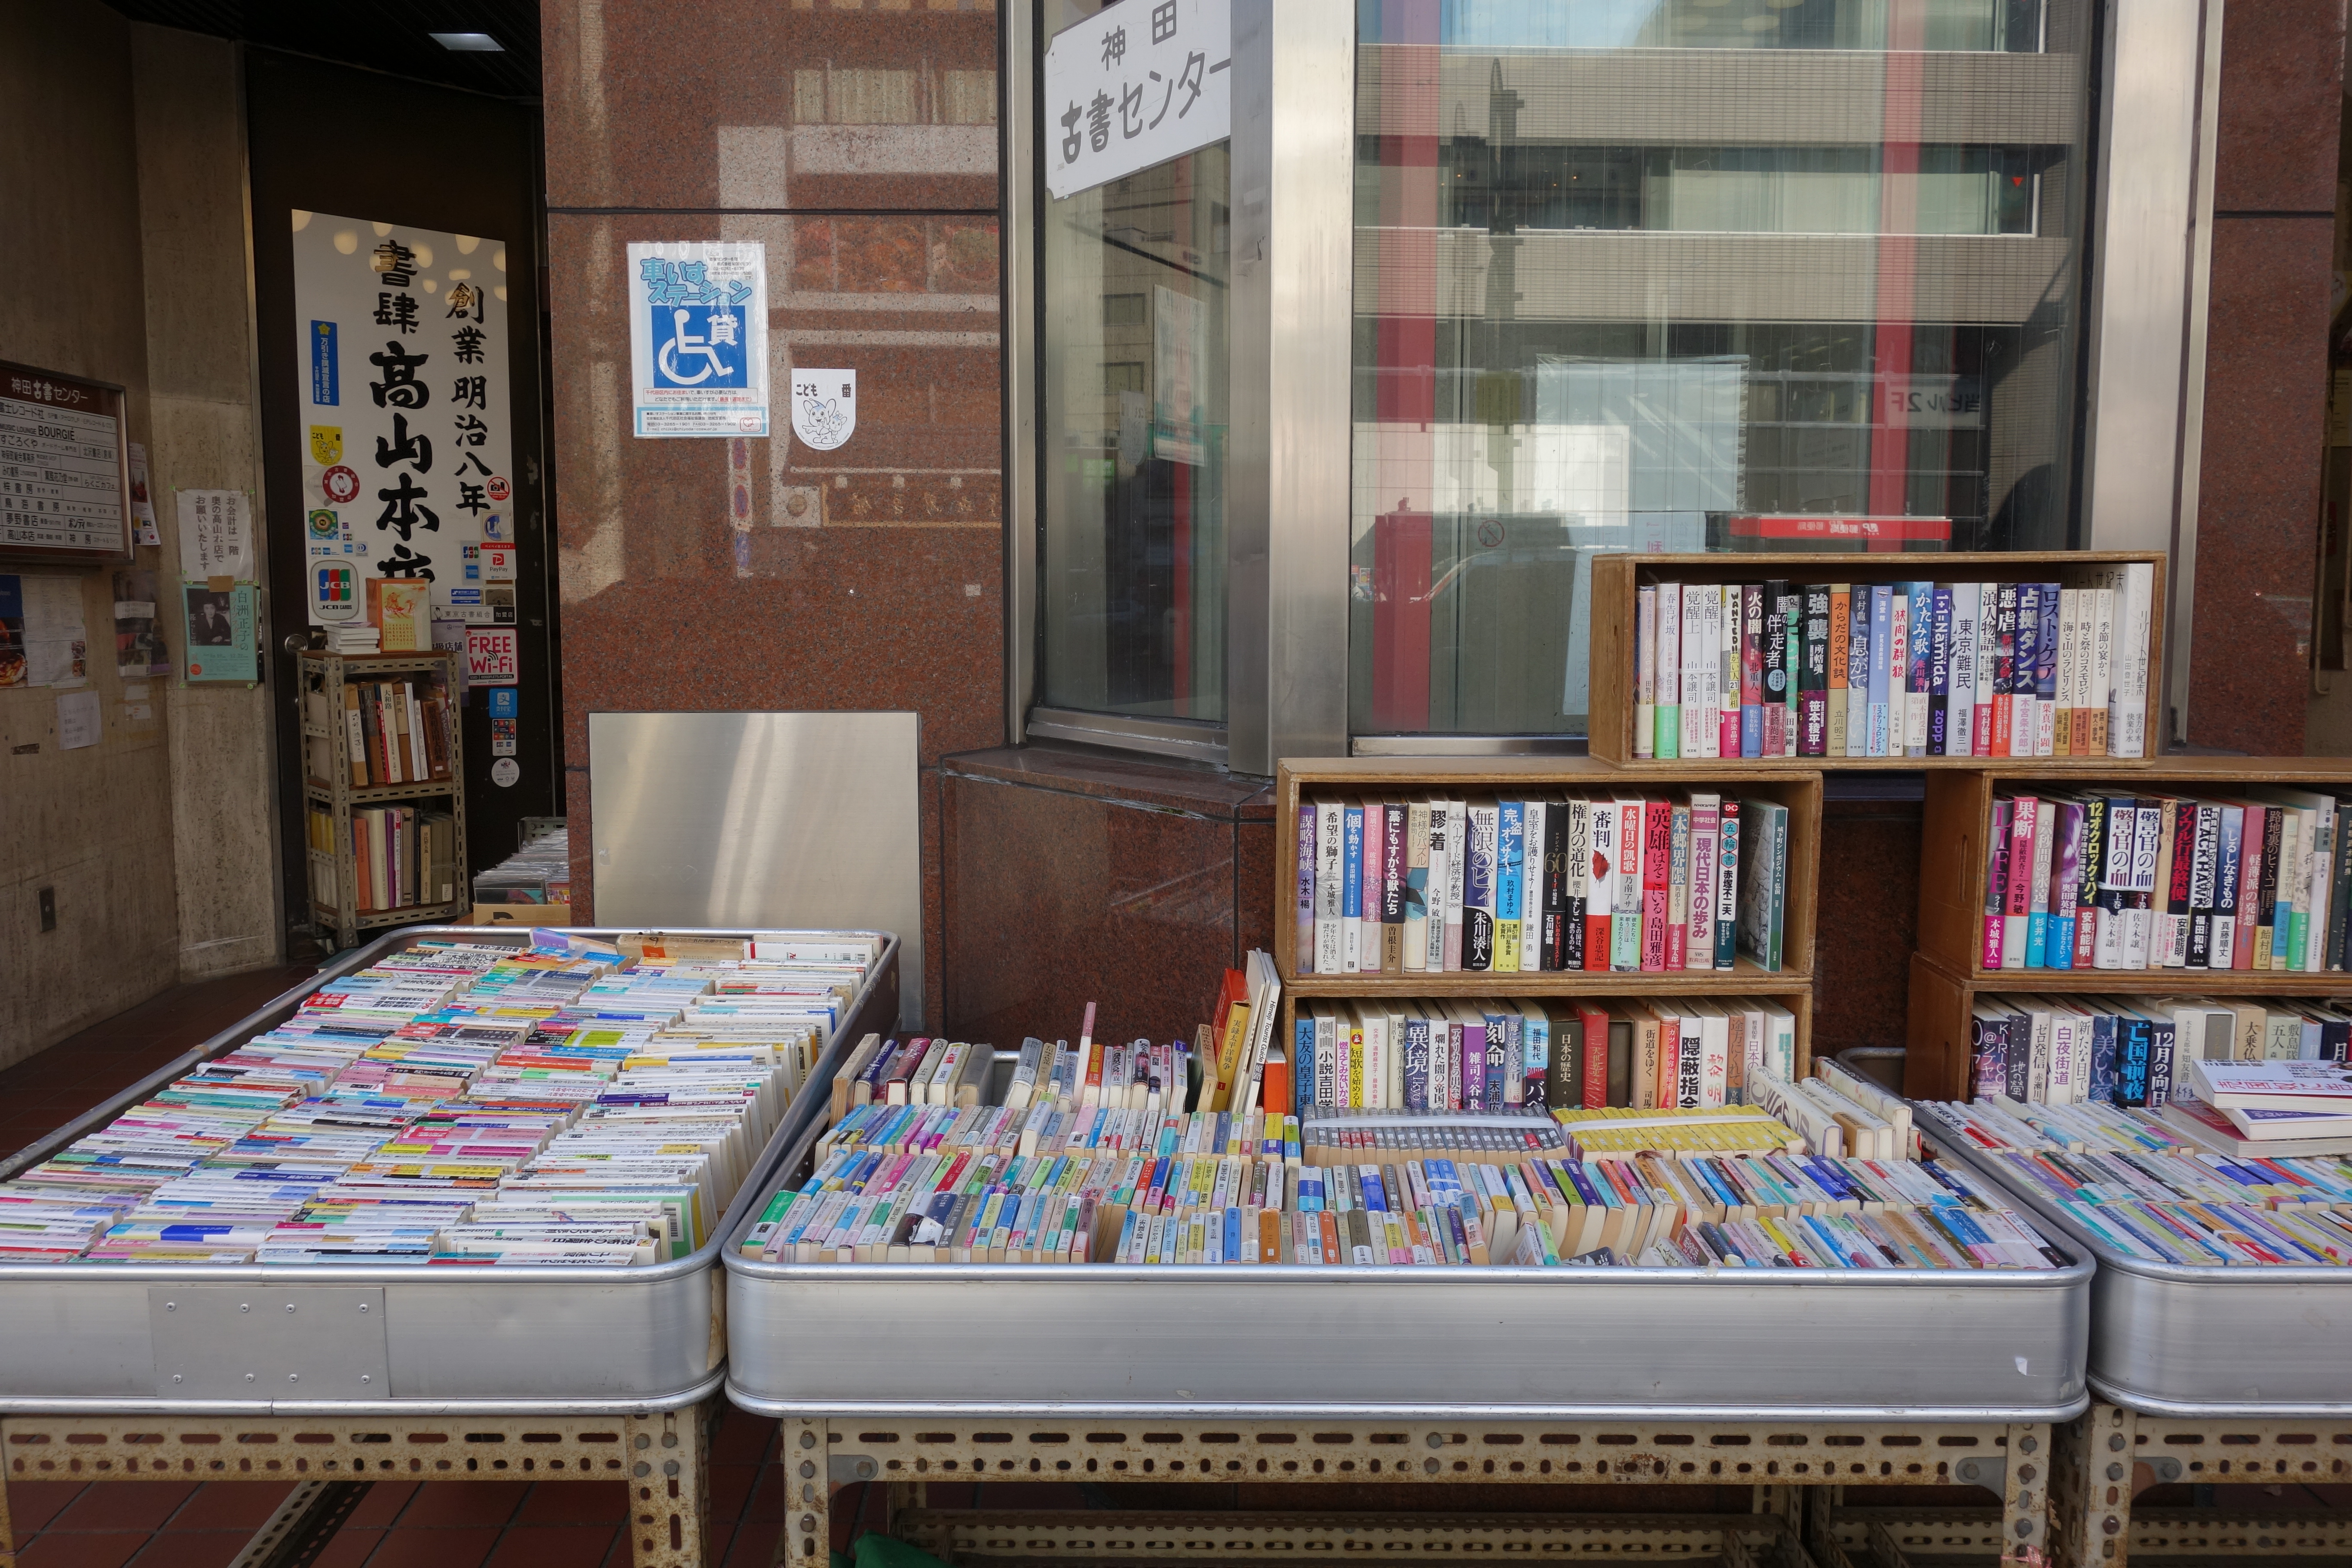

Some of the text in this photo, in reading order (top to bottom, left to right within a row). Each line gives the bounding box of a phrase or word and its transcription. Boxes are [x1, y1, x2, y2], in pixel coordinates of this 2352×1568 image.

[1102, 0, 1176, 71] 神田
[1061, 51, 1231, 164] 古書センター
[374, 240, 420, 334] 書肆
[640, 257, 708, 285] 車いす
[648, 280, 752, 307] ステーション
[707, 314, 738, 346] 貸
[12, 377, 88, 403] 神田古書センター
[445, 282, 493, 518] 創業明治八年
[796, 383, 818, 397] こども
[0, 435, 38, 449] すごろくや
[38, 425, 75, 441] BOURGIÉ
[84, 479, 115, 490] らくごカフェ
[7, 530, 35, 542] 高山本店
[196, 495, 209, 571] お願いいたします
[211, 496, 225, 563] 奥の高山本店で
[227, 496, 239, 556] お会計は一階
[237, 591, 250, 650] 白洲正子の
[445, 610, 490, 619] 東京古書組合
[1665, 593, 1675, 635] 春告げ坂
[1748, 592, 1762, 634] 火の闇
[1807, 593, 1828, 640] 強襲
[1913, 593, 1931, 654] かたみ歌
[1997, 588, 2017, 631] 悪虐
[432, 641, 463, 652] 扱店舗
[469, 636, 511, 653] FREE
[1766, 597, 1788, 668] 闇の 伴走者
[1834, 601, 1847, 678] からだの文化誌
[1956, 619, 1973, 689] 東京難民
[2016, 588, 2040, 687] 占拠ダンス
[2038, 591, 2058, 680] ロスト・ケア
[2098, 622, 2110, 678] 季節の宴から
[469, 656, 513, 673] Wi-Fi
[1644, 639, 1653, 676] 花合せ
[1749, 662, 1758, 691] 北重人
[2061, 622, 2074, 702] 海と山のラビリンス
[2079, 622, 2092, 704] 時と祭のコスモロジー
[1850, 636, 1868, 738] 息ができない
[1770, 707, 1779, 745] 長崎尚志
[1809, 701, 1820, 745] 笹本稜平
[1834, 710, 1844, 740] 立川昭二
[1957, 709, 1967, 744] 福澤徹三
[1981, 707, 1991, 745] 野村敏雄
[2018, 698, 2030, 747] 木宮条太郎
[1345, 813, 1362, 858] 個を動かす
[1416, 810, 1427, 866] 神様のパズル
[1430, 810, 1446, 851] 膠着
[1569, 804, 1587, 878] 権力の道化
[1592, 811, 1611, 848] 審判
[1623, 808, 1637, 872] 水曜日の凱歌
[2013, 801, 2035, 838] 果断
[1299, 815, 1314, 872] 謀略海峡
[1387, 810, 1400, 915] 藁にもすがる獣たち
[1544, 852, 1568, 873] 60
[1648, 808, 1669, 914] 英雄はそこにいる
[1671, 815, 1687, 885] 本郷界隈
[1989, 806, 2012, 894] LIFE
[2110, 810, 2133, 886] 警官の血
[2136, 811, 2158, 887] 警官の血
[2171, 807, 2198, 901] ソウル行最終便
[1692, 838, 1712, 939] 現代日本の歩み
[2221, 830, 2237, 908] しるしなきもの
[1431, 888, 1440, 917] 今野敏
[1506, 880, 1515, 915] 玖村まゆみ
[1572, 880, 1581, 922] 櫻井よしこ
[1624, 876, 1632, 908] 乃南アサ
[1722, 870, 1733, 916] 赤塚不二夫
[2013, 884, 2025, 914] 今野敏
[1387, 926, 1396, 963] 曽根圭介
[1473, 912, 1486, 962] 朱川湊人
[1546, 915, 1554, 944] 石川智健
[1649, 917, 1663, 967] 島田雅彦
[1671, 930, 1680, 962] 司馬遼太郎
[1989, 919, 2000, 958] 本城雅人
[2079, 912, 2093, 957] 安東能明
[2174, 918, 2187, 957] 安東能明
[2193, 916, 2206, 954] 福田和代
[2219, 921, 2230, 957] 真藤順丈
[1224, 1020, 1241, 1070] 実録太平洋戦争
[1258, 1044, 1267, 1063] Guide
[1263, 1023, 1272, 1043] Tourist
[1406, 1026, 1428, 1077] 異境
[1507, 1022, 1519, 1082] 海に沈んだ町
[1532, 1029, 1541, 1060] 福田和代
[1645, 1029, 1655, 1077] 街道をゆく
[2032, 1023, 2049, 1069] ゼロ発信
[1560, 1034, 1572, 1082] 日本の歴史
[1666, 1029, 1675, 1090] カツラ美容室別室
[2054, 1027, 2072, 1085] 白夜街道
[2125, 1023, 2150, 1100] 亡国前夜
[1412, 1077, 1424, 1101] Ikyo
